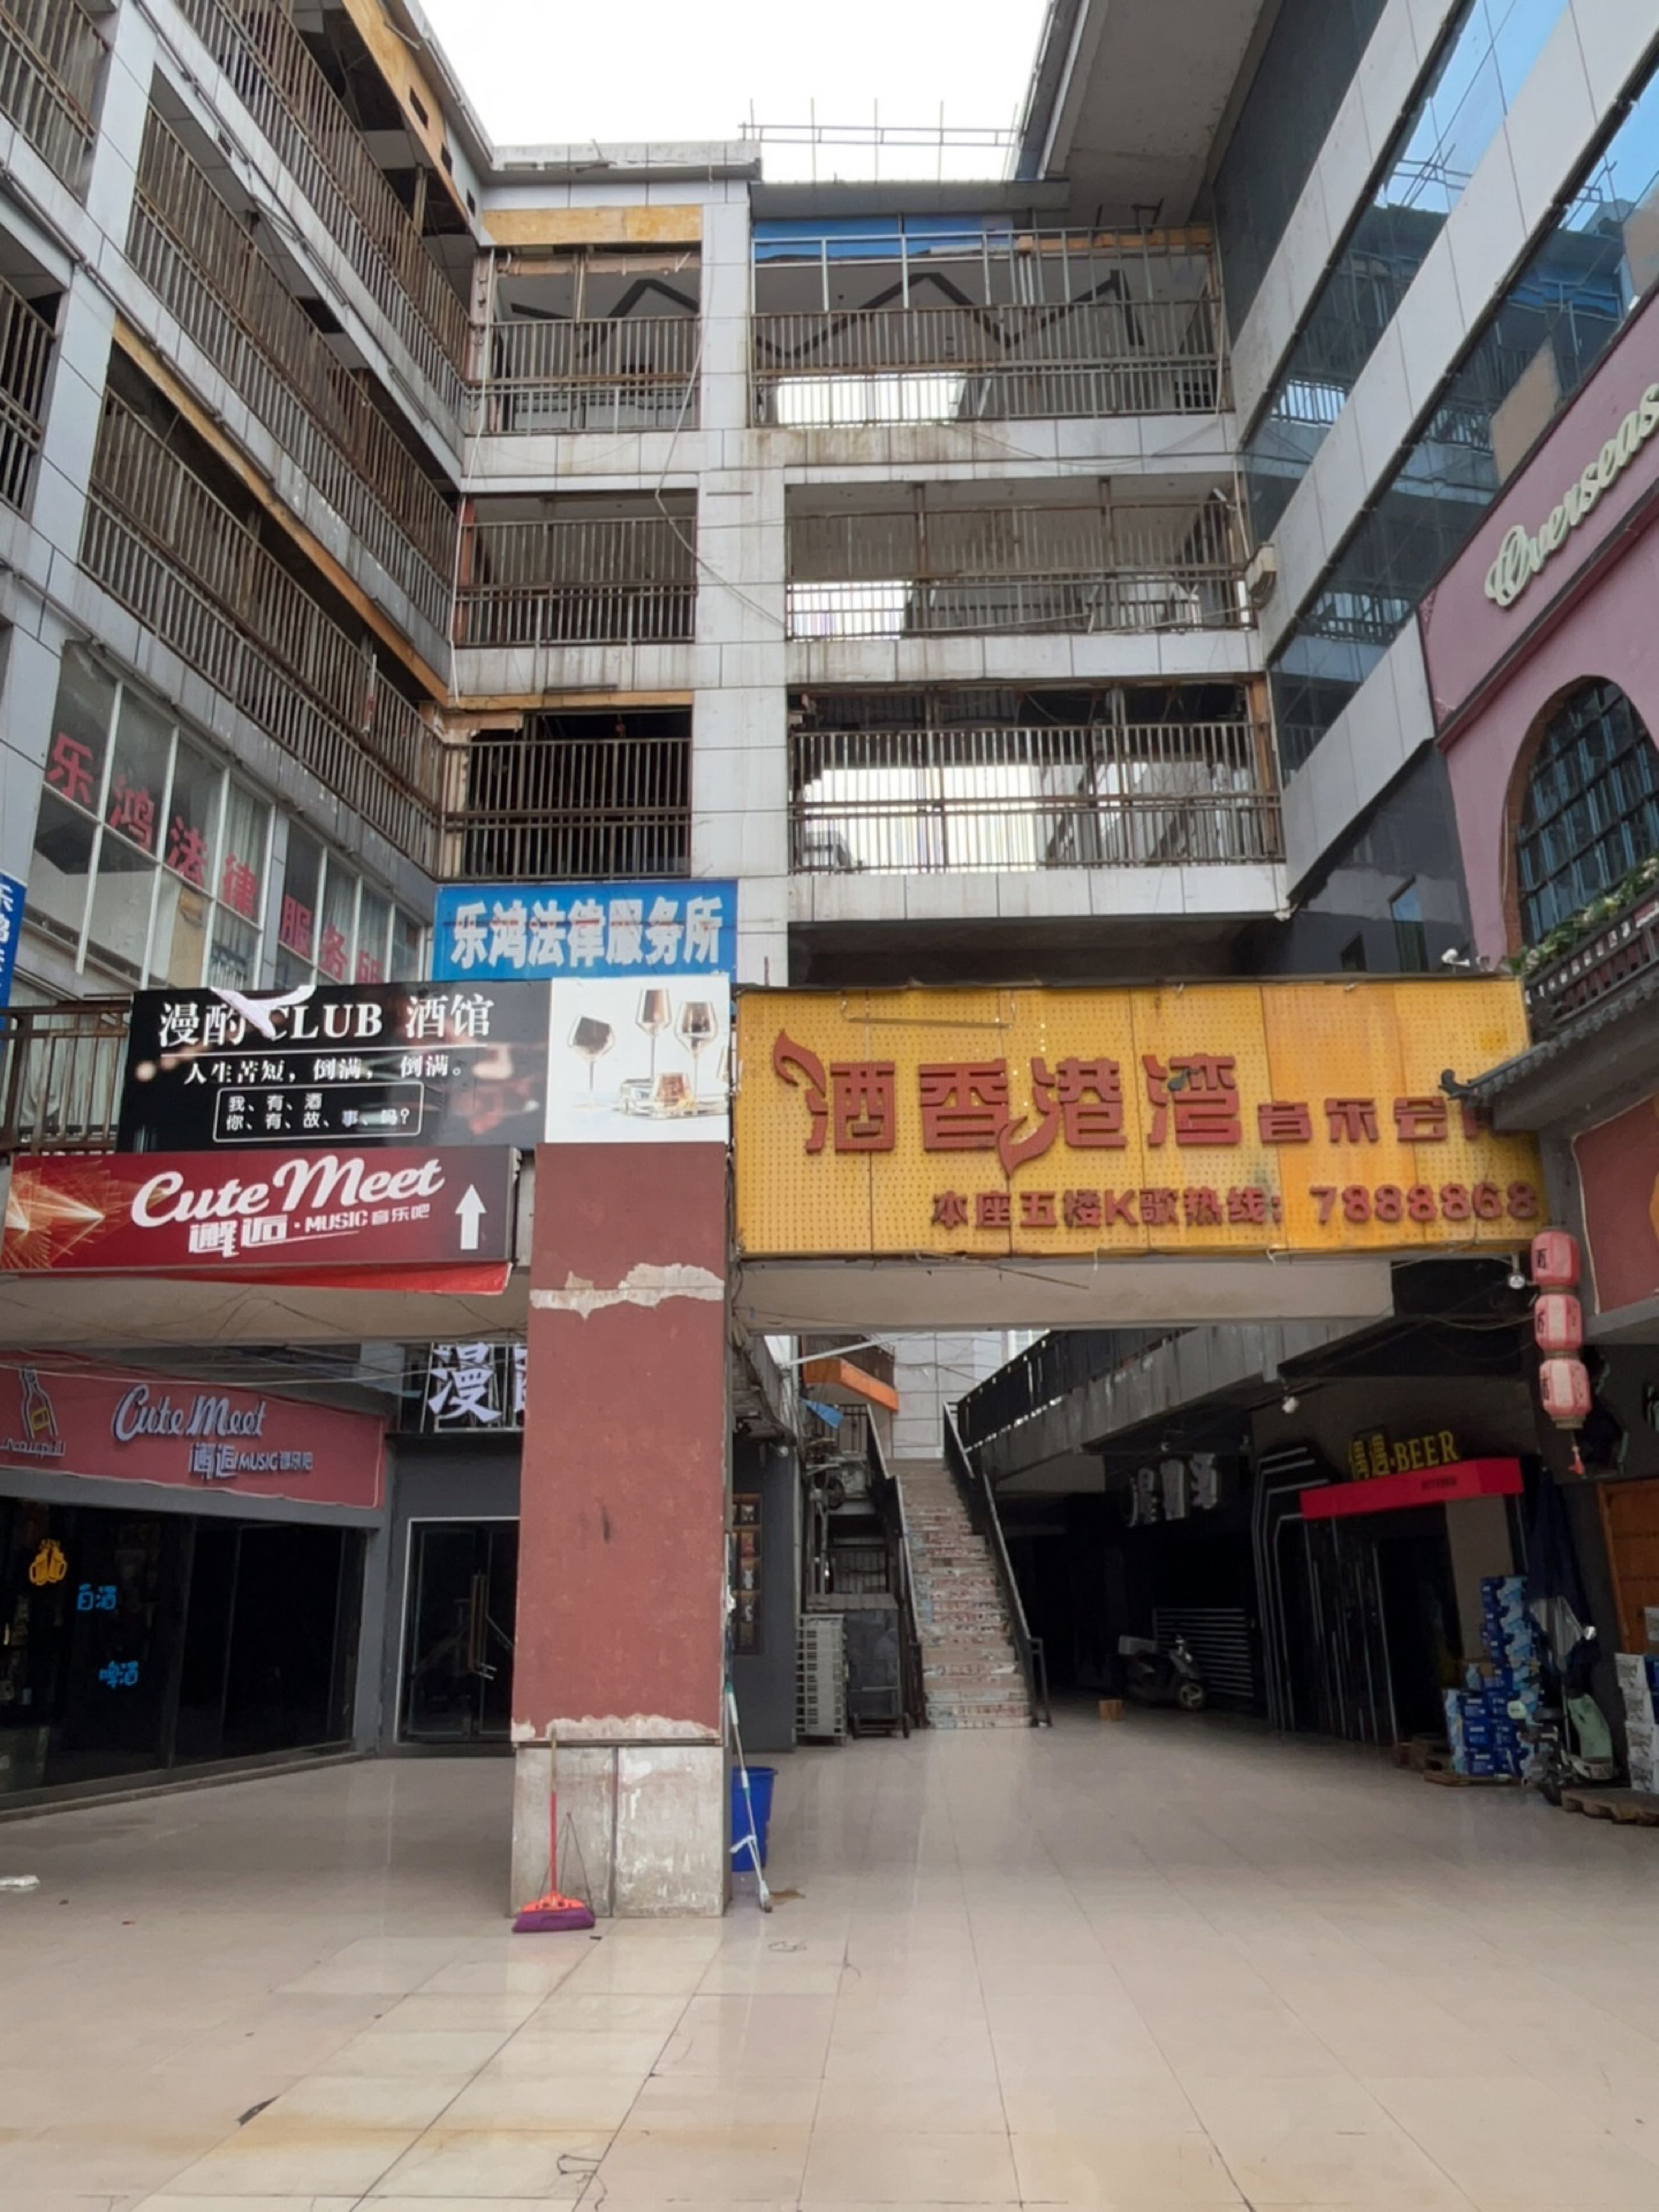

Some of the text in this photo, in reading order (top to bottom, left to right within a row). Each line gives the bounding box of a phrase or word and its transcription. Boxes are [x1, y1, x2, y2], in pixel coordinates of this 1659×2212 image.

[451, 896, 723, 969] 乐鸿法律服务所
[405, 993, 495, 1037] 酒馆
[773, 1029, 1526, 1177] 酒香港湾 音乐会
[131, 1154, 445, 1228] Cute Meet
[1310, 1182, 1538, 1225] 7888868
[188, 1214, 287, 1258] 邂逅
[371, 1203, 431, 1225] 音乐吧
[428, 1342, 528, 1423] 漫
[111, 1384, 266, 1443] Cute Meet
[237, 1451, 278, 1471] MUSIC
